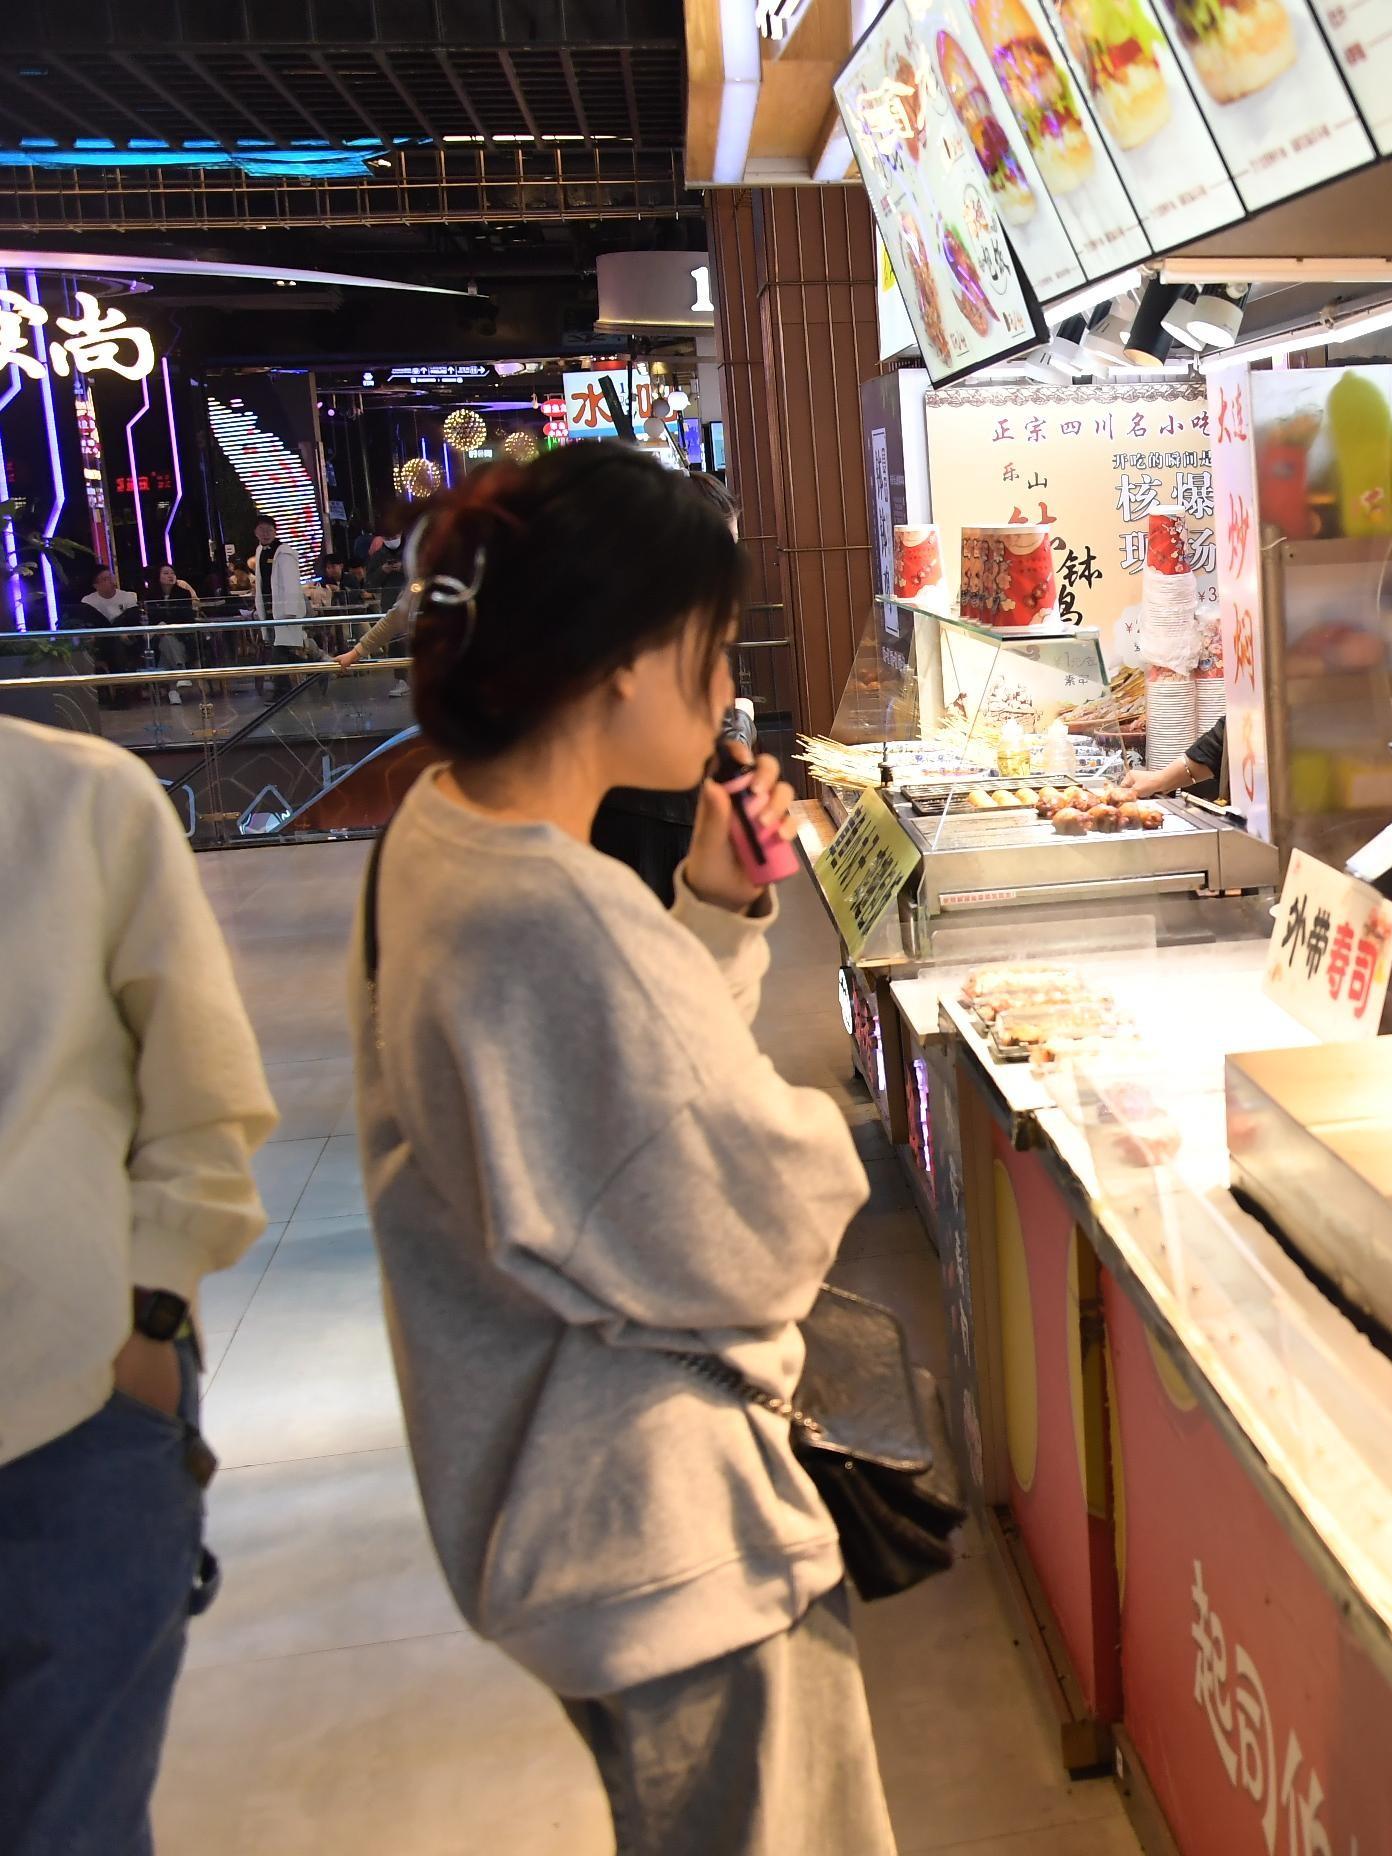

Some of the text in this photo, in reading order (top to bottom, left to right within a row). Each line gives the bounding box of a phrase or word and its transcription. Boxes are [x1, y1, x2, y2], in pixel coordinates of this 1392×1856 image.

[991, 411, 1211, 443] 正宗四川名小吃
[1112, 449, 1212, 470] 开吃的瞬间是
[1115, 471, 1215, 523] 核爆
[1281, 893, 1378, 1020] 外带寿司
